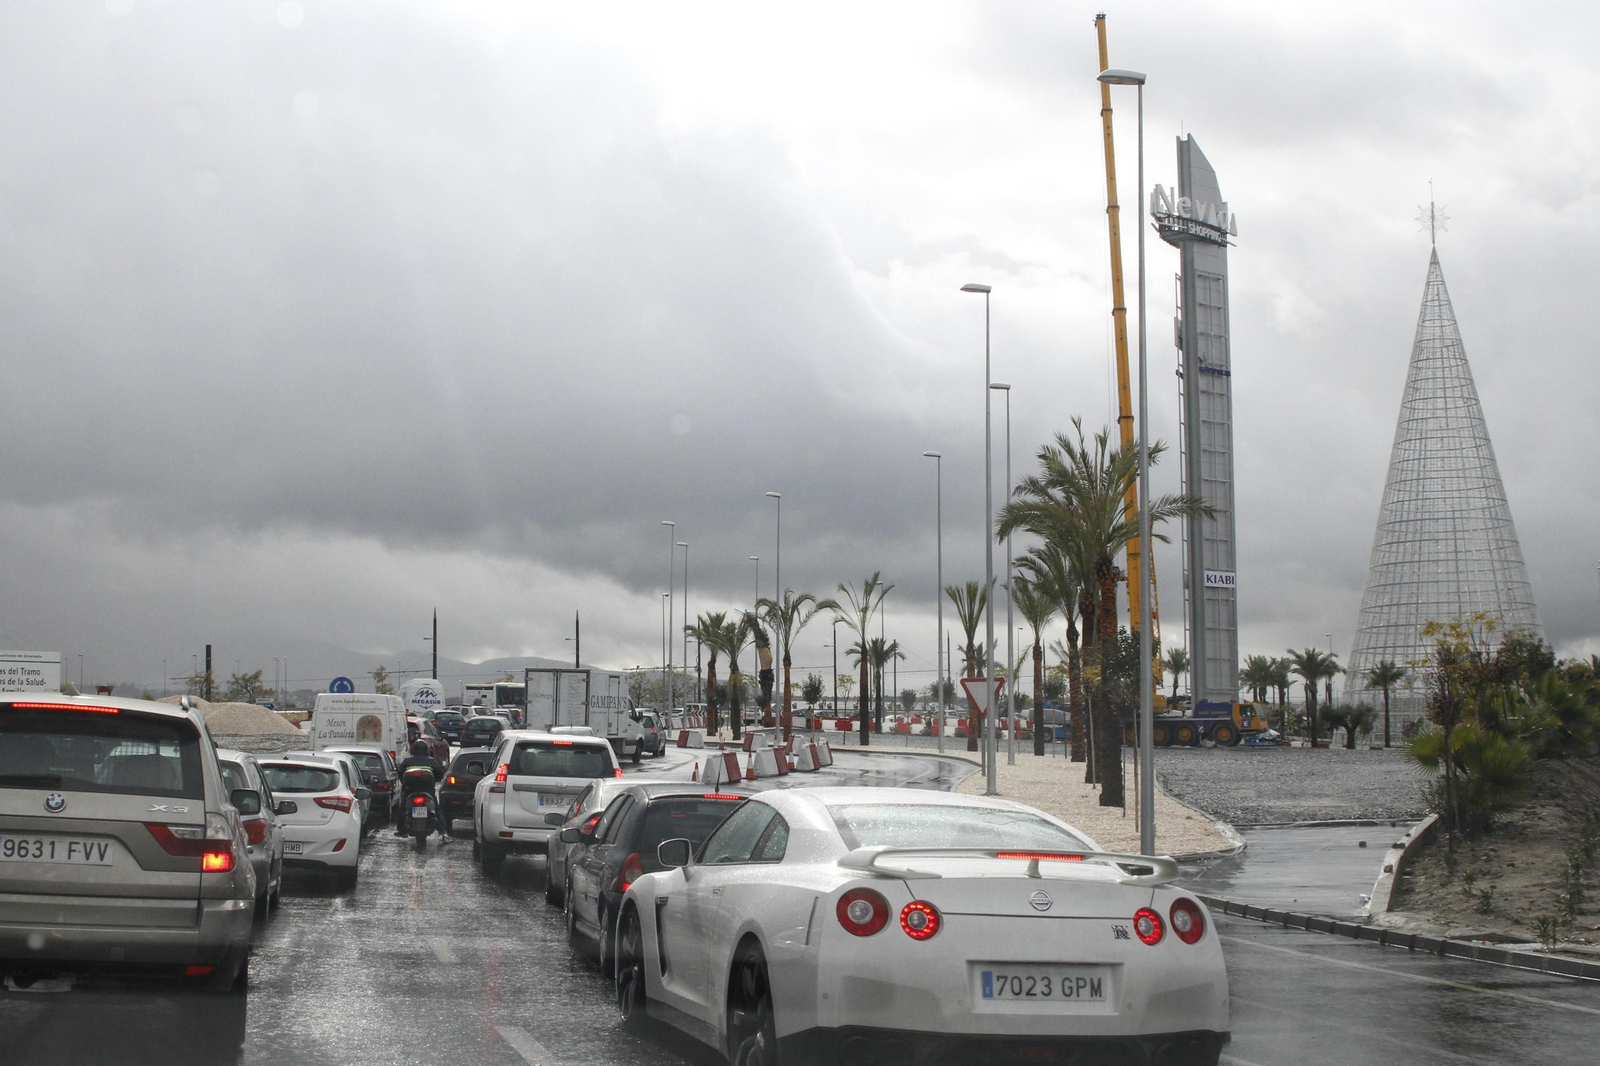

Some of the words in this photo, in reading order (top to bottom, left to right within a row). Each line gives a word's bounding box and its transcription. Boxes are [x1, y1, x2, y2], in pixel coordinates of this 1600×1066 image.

[1188, 222, 1222, 243] SHOPPING
[1206, 573, 1235, 585] KIABI
[8, 666, 19, 675] del
[20, 667, 41, 676] Tramo
[18, 678, 24, 686] la
[25, 677, 47, 686] Salud-
[325, 718, 347, 728] Mesón
[317, 729, 327, 739] La
[328, 728, 355, 739] Pataleta
[545, 797, 564, 805] 8937
[148, 803, 190, 814] X3
[3, 838, 57, 860] 9631
[67, 840, 109, 862] FVV
[996, 975, 1053, 997] 7023
[1061, 976, 1103, 998] GPM
